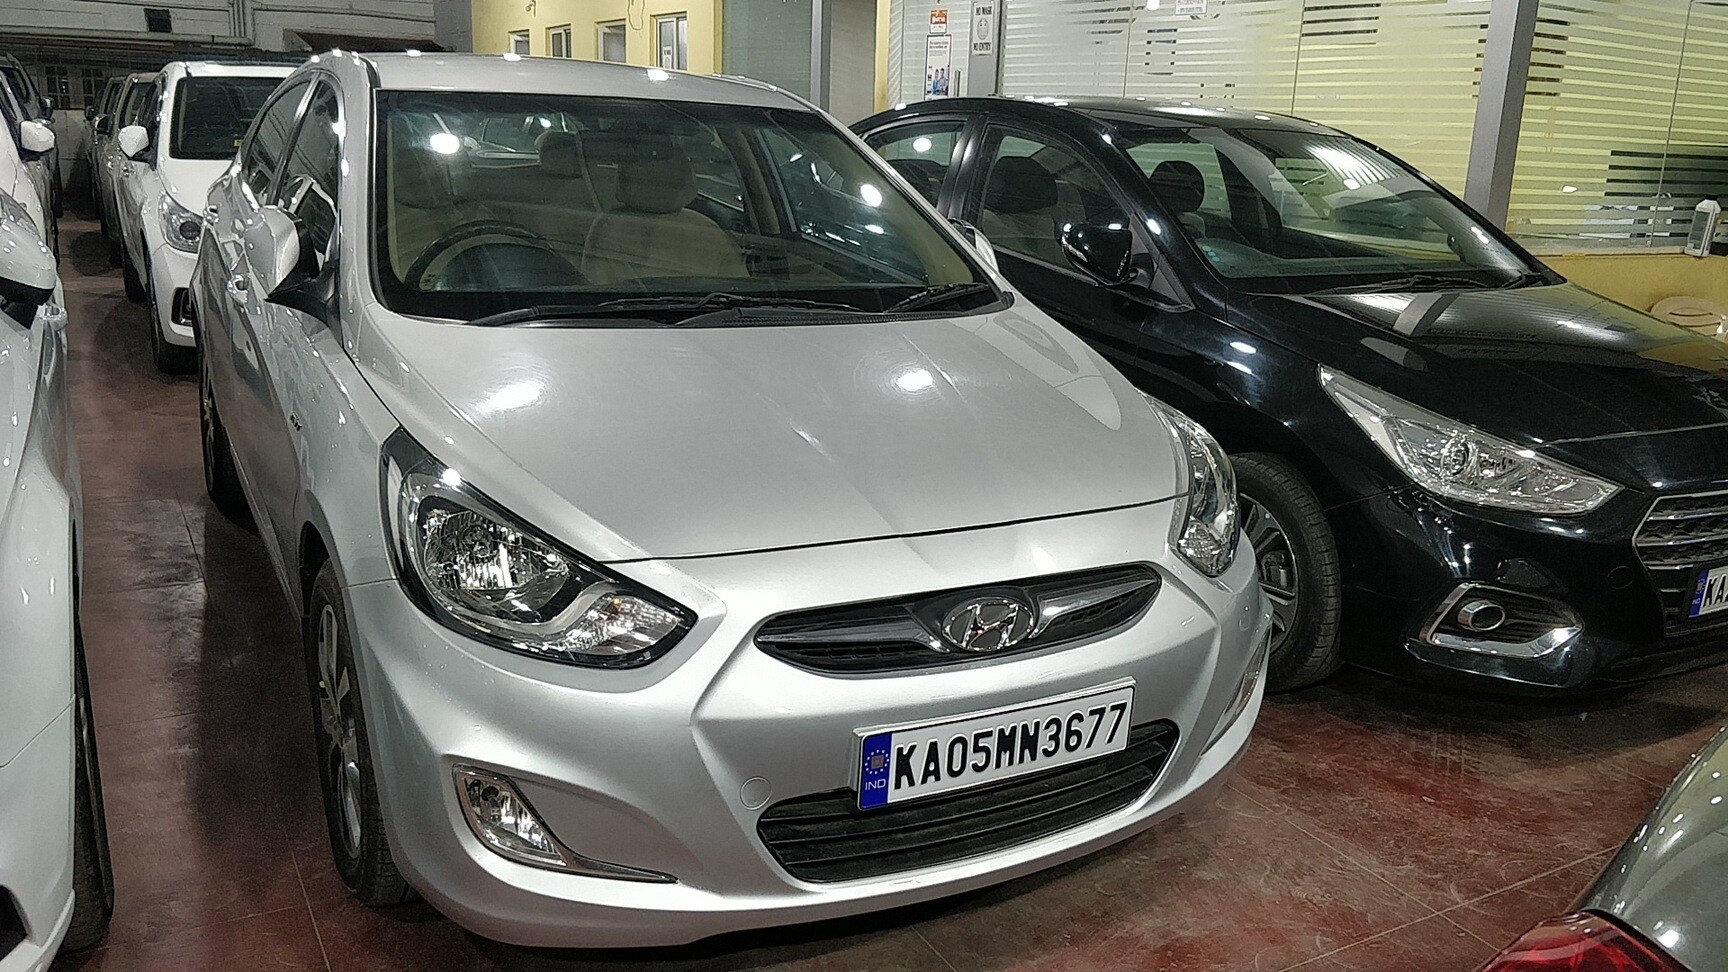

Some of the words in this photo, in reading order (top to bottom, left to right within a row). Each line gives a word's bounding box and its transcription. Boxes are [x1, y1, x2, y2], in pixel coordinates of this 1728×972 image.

[975, 7, 981, 16] NO
[982, 6, 992, 15] MASK
[973, 43, 979, 51] NO
[979, 42, 991, 51] ENTRY
[1703, 574, 1728, 607] KA
[894, 701, 1128, 790] KA05MN3677
[865, 778, 886, 791] IND
